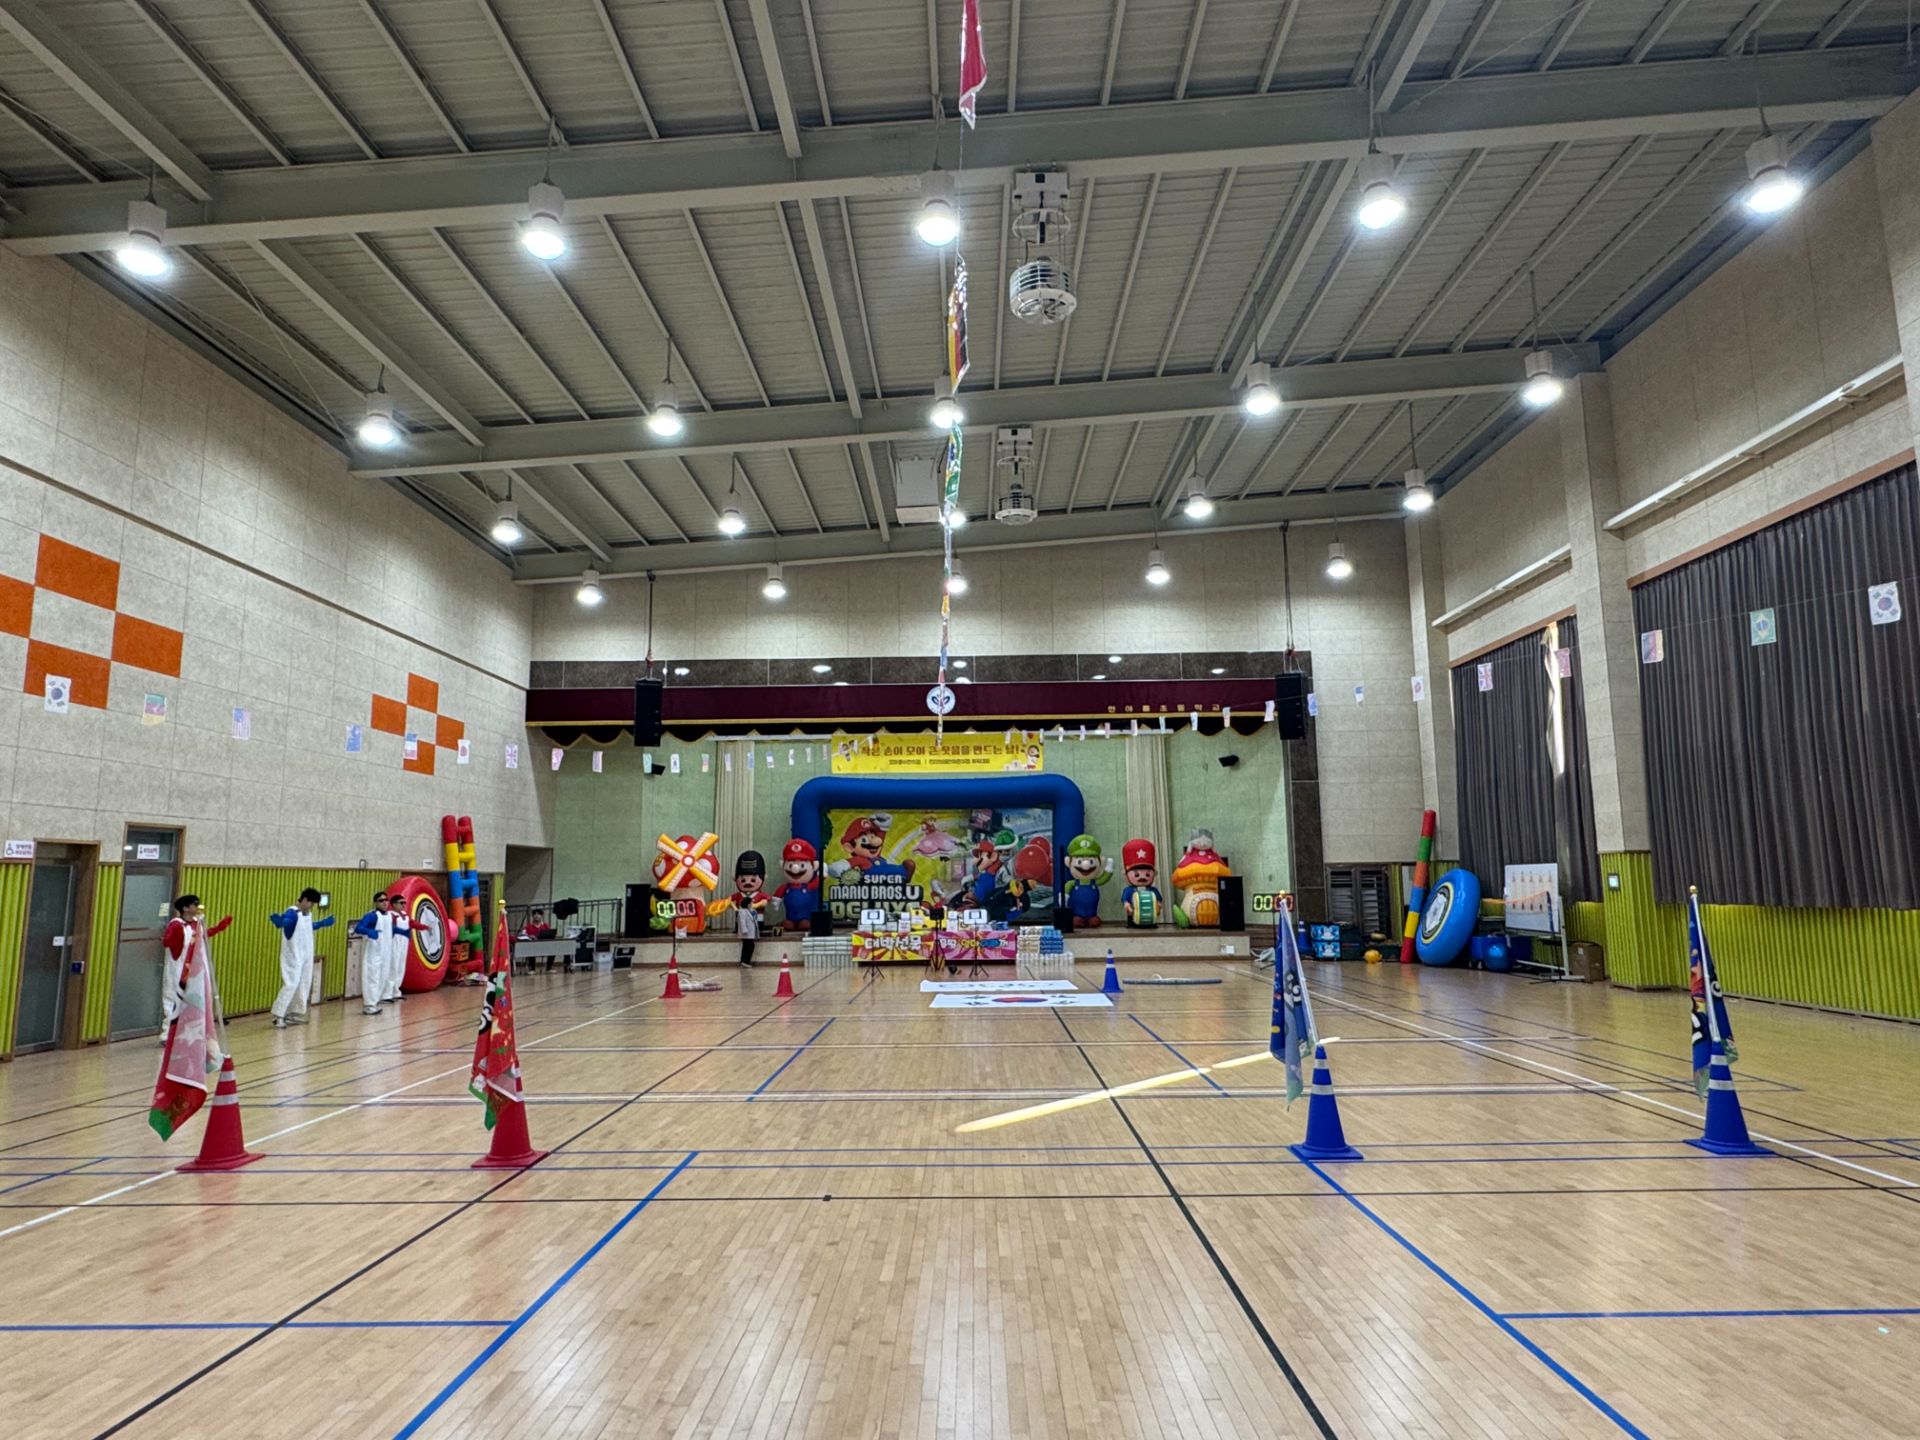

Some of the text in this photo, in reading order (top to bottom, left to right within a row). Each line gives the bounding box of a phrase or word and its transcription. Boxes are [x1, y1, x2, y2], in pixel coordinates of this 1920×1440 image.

[883, 746, 903, 756] 손이
[973, 744, 1003, 755] 만드는
[830, 885, 868, 900] MARIO
